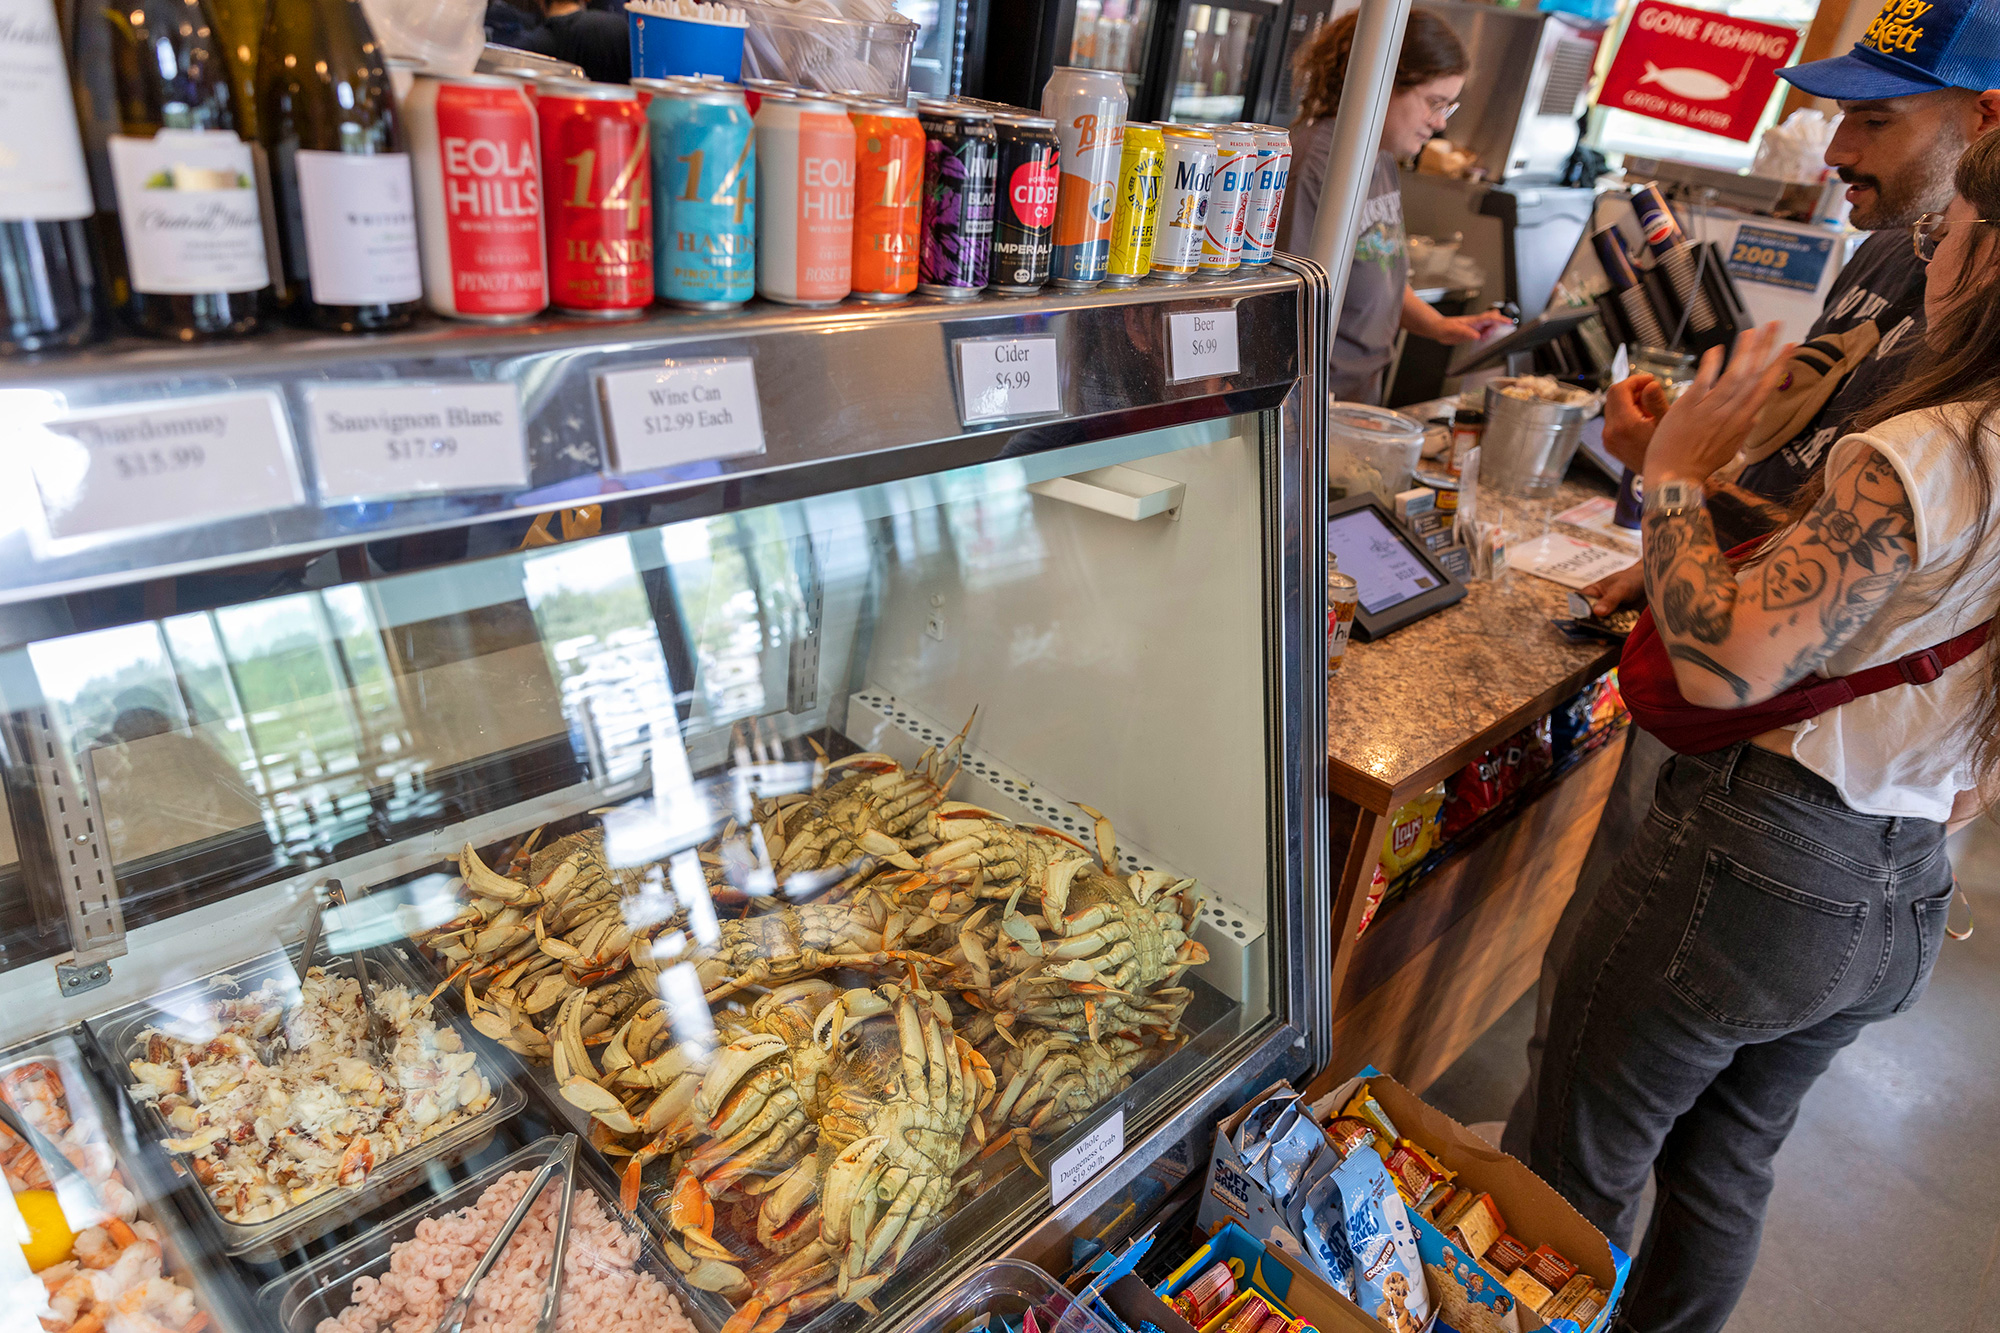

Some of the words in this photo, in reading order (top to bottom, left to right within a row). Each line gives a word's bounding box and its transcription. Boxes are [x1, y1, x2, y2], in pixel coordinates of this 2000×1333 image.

[1638, 7, 1701, 40] GONE
[1700, 20, 1789, 59] FISHING
[1623, 90, 1668, 114] CATCH
[1668, 99, 1688, 119] YA
[1687, 105, 1732, 130] LATER
[443, 136, 537, 177] EOLA
[563, 124, 651, 231] 14
[675, 124, 755, 224] 14
[1174, 161, 1214, 192] Mod
[447, 178, 540, 217] HILLS
[1014, 185, 1059, 205] CIDER
[994, 242, 1048, 255] IMPERIAL
[1732, 243, 1790, 269] 2003
[1193, 316, 1215, 332] Beer
[995, 345, 1029, 363] Cider
[1192, 339, 1217, 355] $6.99
[995, 371, 1030, 390] $6.99
[649, 387, 689, 407] Wine
[692, 385, 721, 403] Can
[327, 409, 441, 434] Sauvignon
[448, 405, 503, 428] Blanc
[643, 413, 694, 435] $12.99
[699, 408, 733, 428] Each
[113, 443, 206, 480] $15.99
[386, 436, 458, 461] $17.99
[1060, 1148, 1098, 1183] Dungeness
[1098, 1133, 1116, 1152] Crab
[1076, 1134, 1099, 1155] Whole
[1072, 1161, 1096, 1187] $19.99
[1098, 1154, 1105, 1166] lb
[1216, 1158, 1251, 1193] SOFT
[1224, 1159, 1242, 1174] mini
[1214, 1170, 1249, 1203] BAKED
[1346, 1199, 1371, 1231] SOFT
[1319, 1220, 1347, 1267] SOFT
[1502, 1239, 1527, 1258] Austin
[1544, 1252, 1570, 1273] Austin
